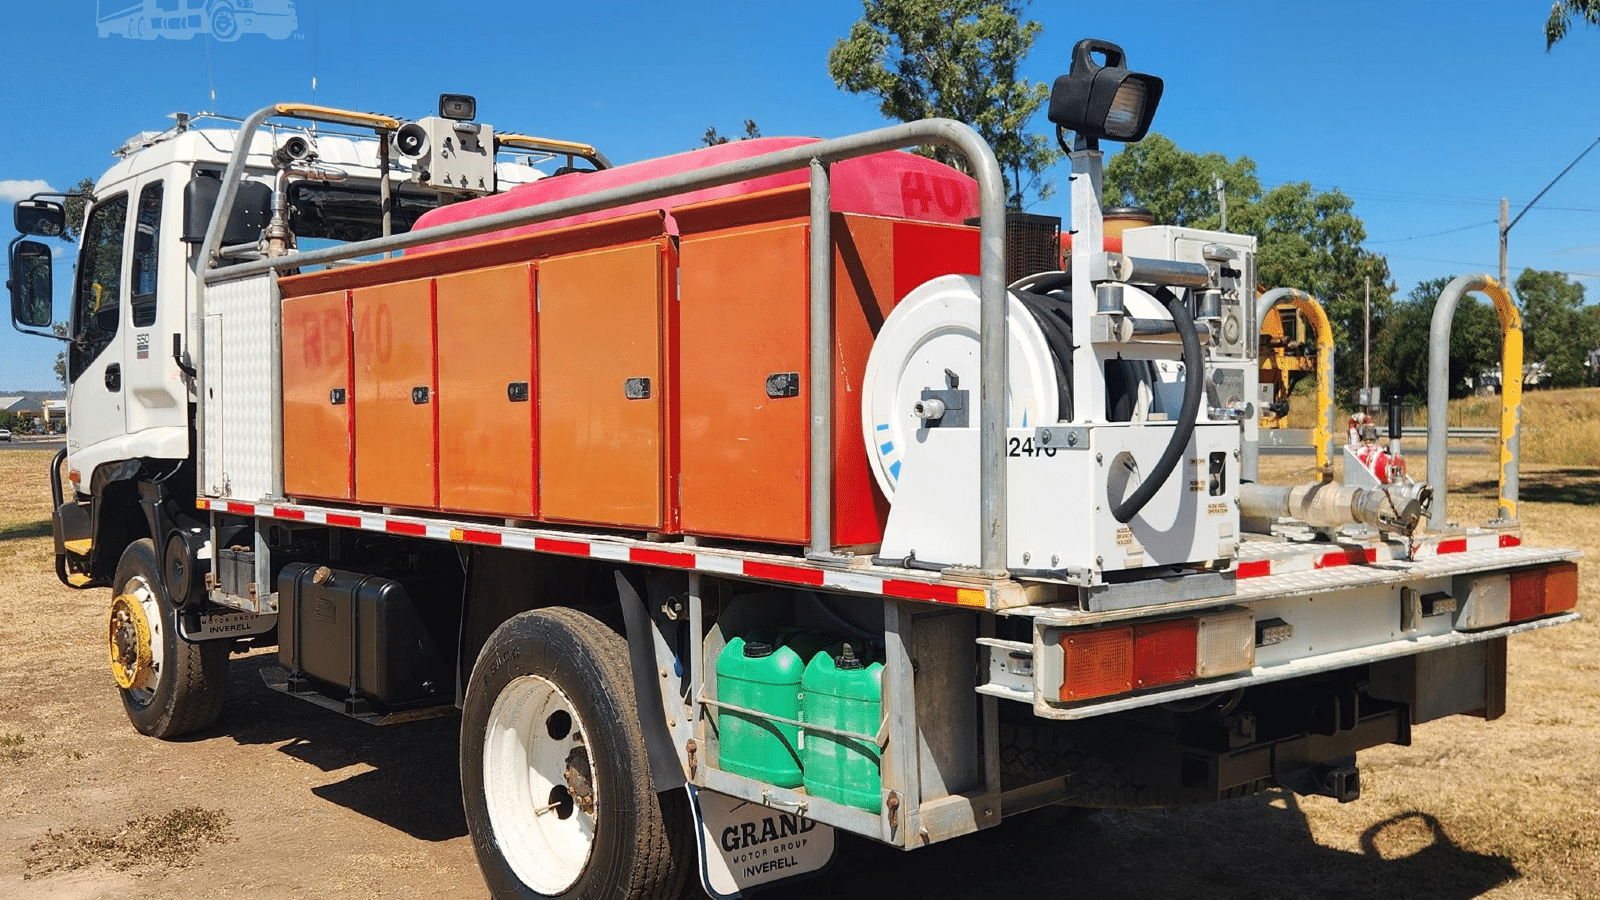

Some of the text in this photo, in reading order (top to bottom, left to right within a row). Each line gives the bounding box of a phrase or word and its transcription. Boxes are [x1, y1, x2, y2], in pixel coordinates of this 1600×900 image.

[137, 333, 149, 345] 550
[302, 303, 393, 368] RB 40
[202, 617, 229, 625] MOTOR
[210, 623, 252, 633] INVERELL
[721, 813, 817, 852] GRAND
[733, 839, 808, 864] MOTOR GROUP
[743, 855, 798, 878] INVERELL
